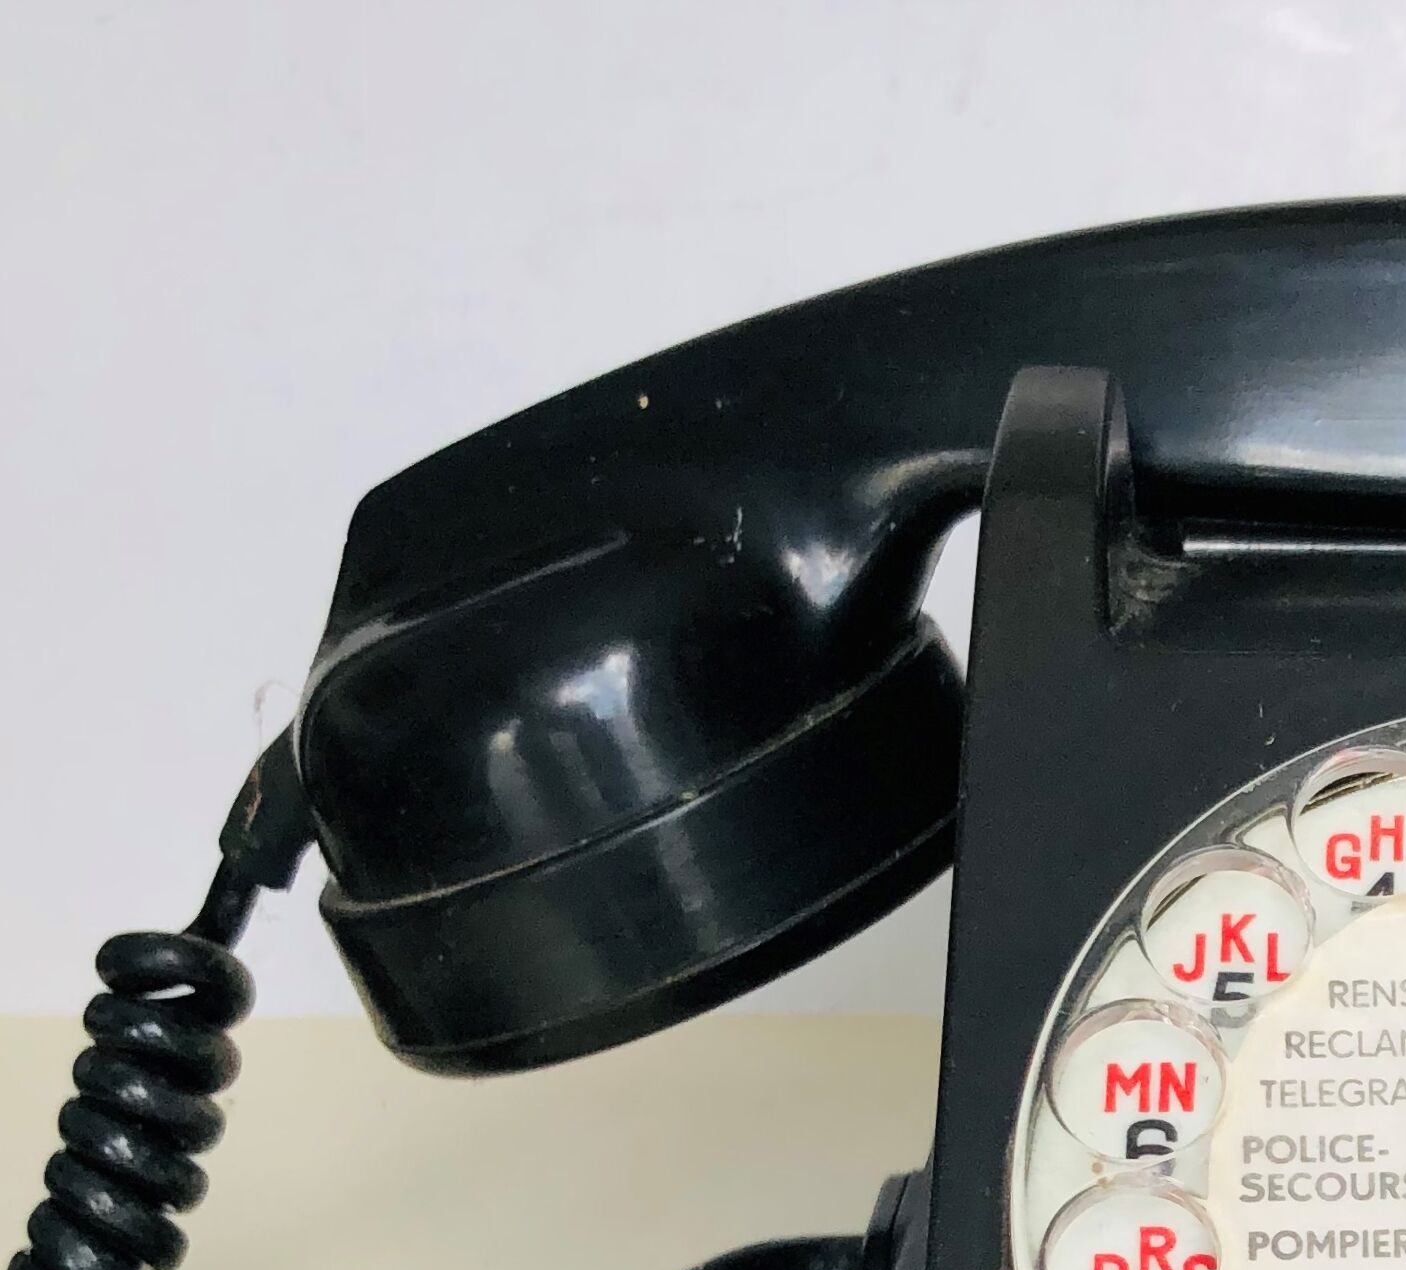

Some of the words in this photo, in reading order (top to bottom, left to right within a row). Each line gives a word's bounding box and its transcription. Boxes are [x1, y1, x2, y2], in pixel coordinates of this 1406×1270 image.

[1173, 914, 1290, 983] JKL
[1104, 1062, 1197, 1113] MN
[1242, 1134, 1389, 1165] POLICE-
